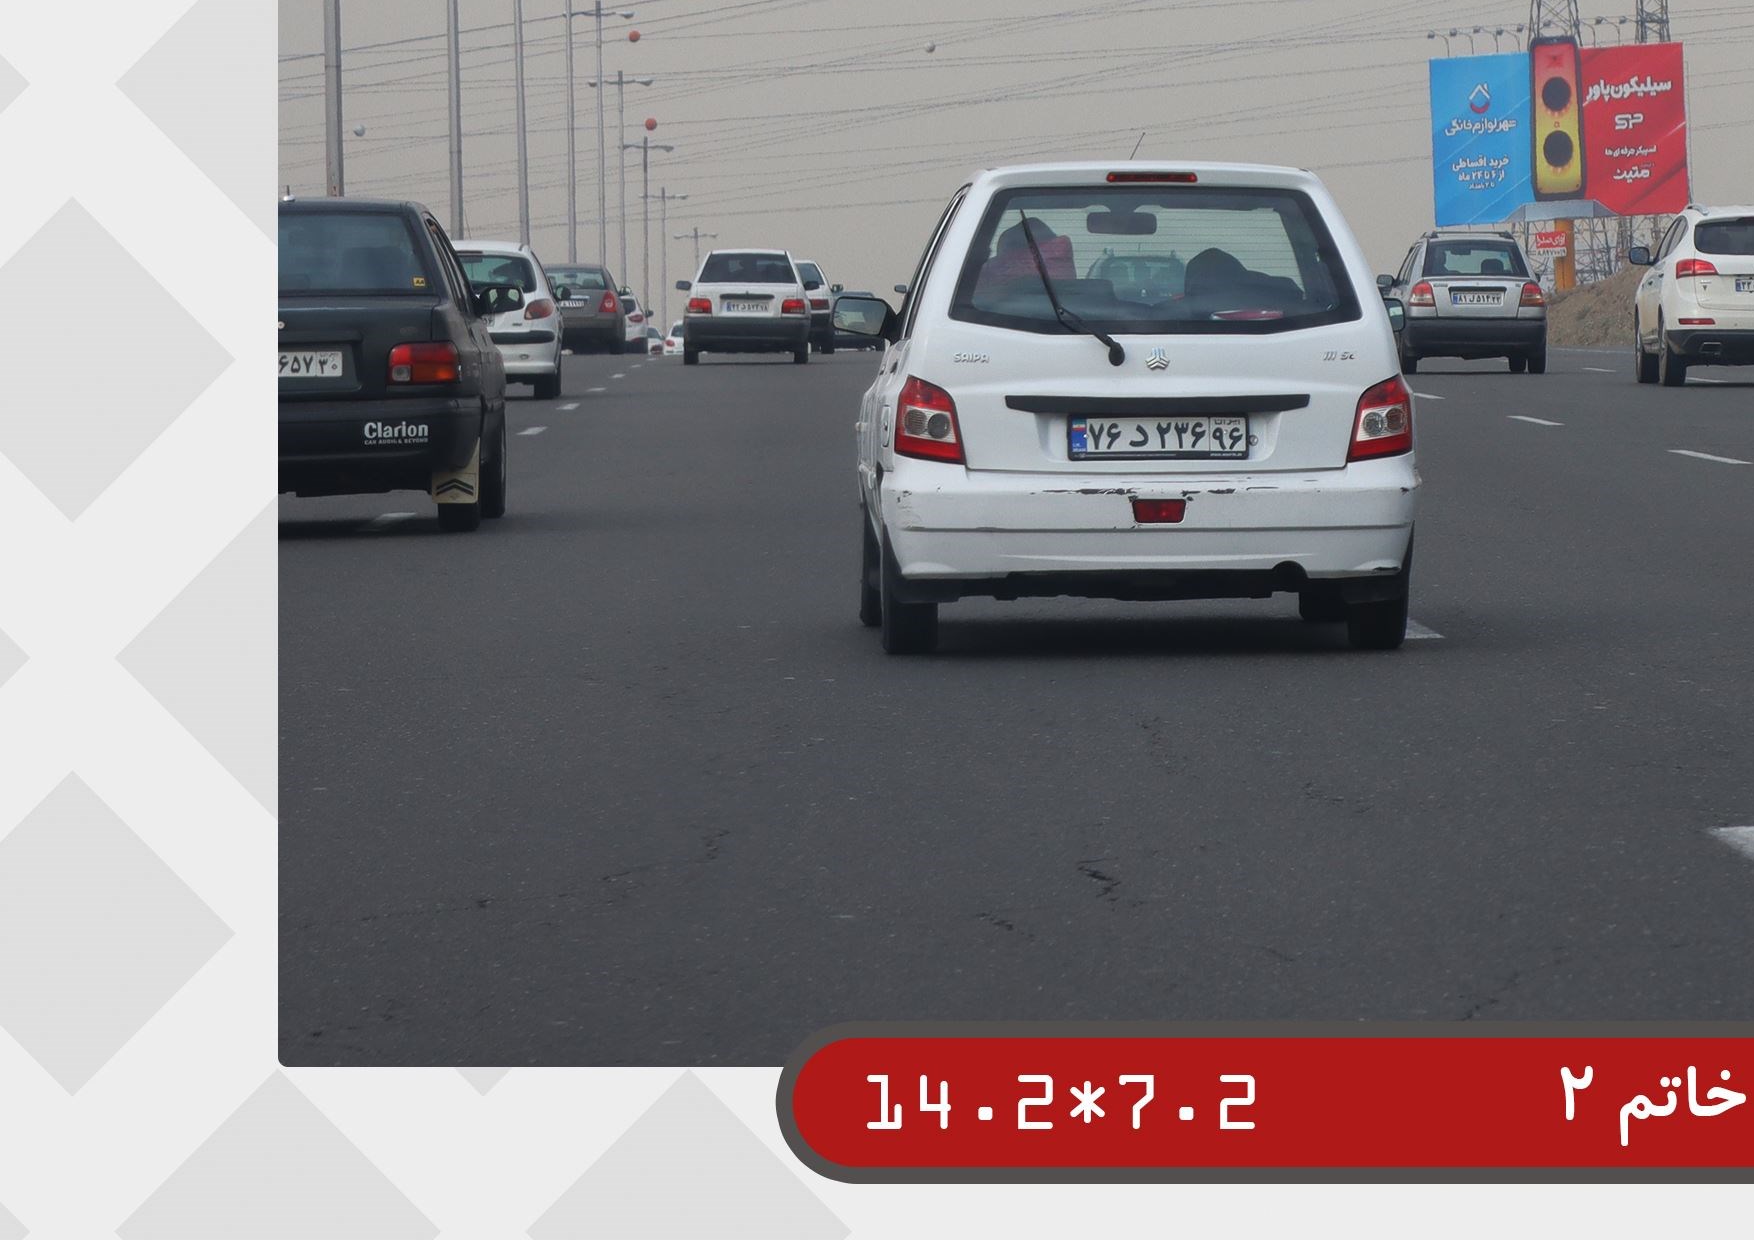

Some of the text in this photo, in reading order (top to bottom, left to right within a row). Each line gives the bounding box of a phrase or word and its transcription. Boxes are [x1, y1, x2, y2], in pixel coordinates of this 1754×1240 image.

[1610, 76, 1672, 98] سیلیکون
[1445, 118, 1473, 136] خانگی
[1615, 113, 1644, 130] SP
[1452, 154, 1510, 171] خرید اقساطی
[364, 421, 429, 439] Clarion
[1089, 422, 1122, 450] ۷۶
[1212, 426, 1244, 451] ۹۶
